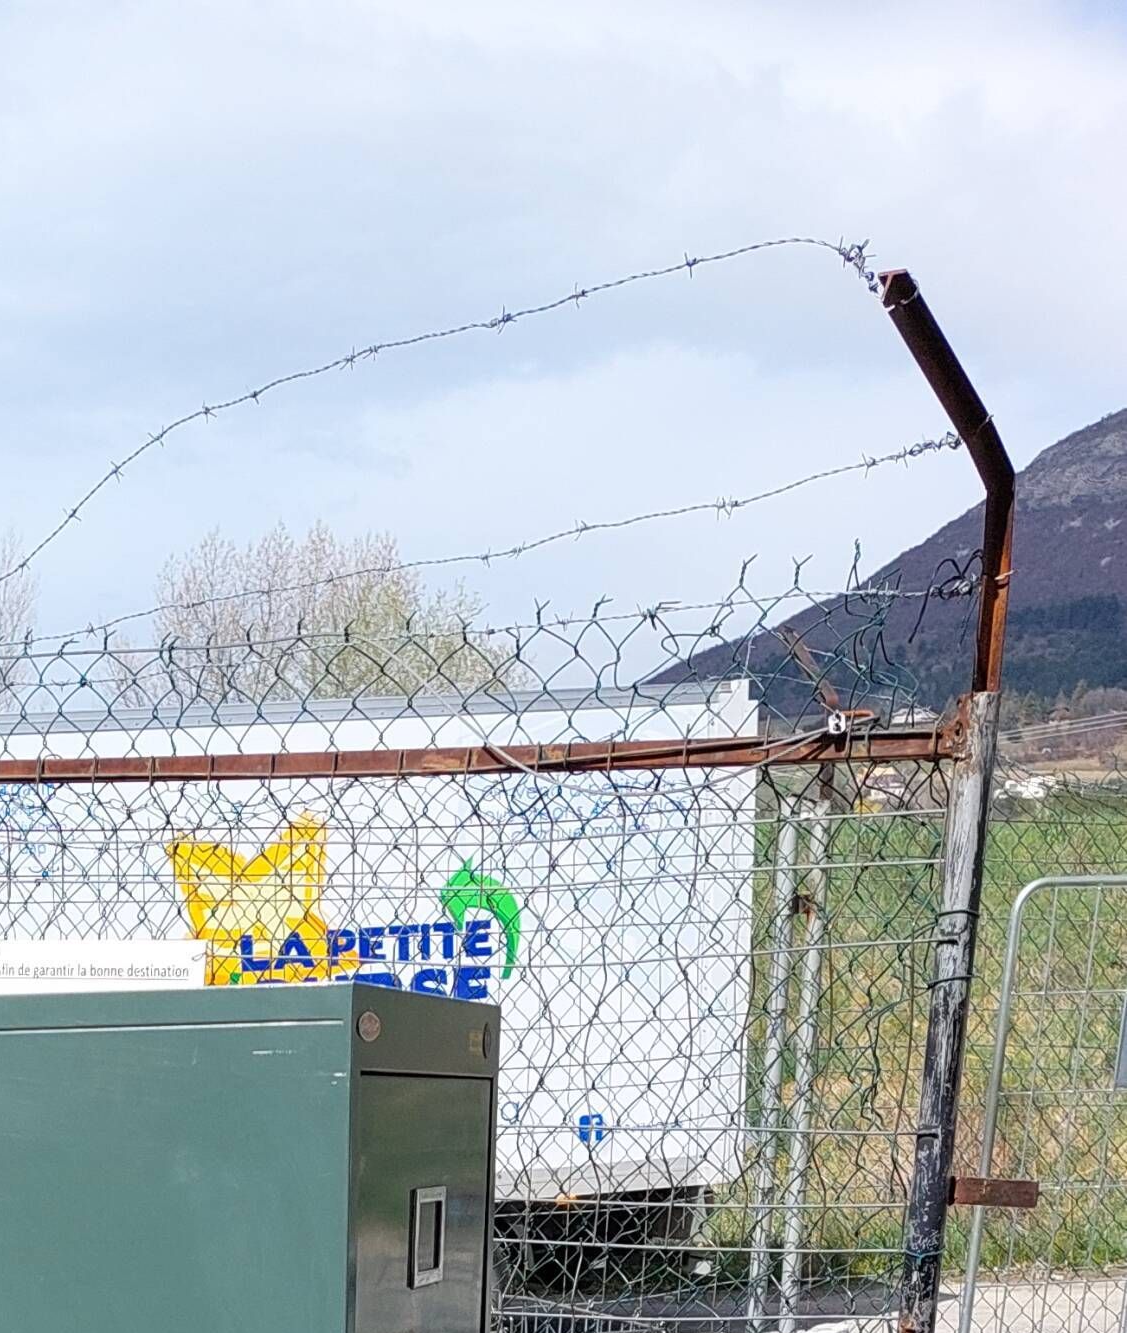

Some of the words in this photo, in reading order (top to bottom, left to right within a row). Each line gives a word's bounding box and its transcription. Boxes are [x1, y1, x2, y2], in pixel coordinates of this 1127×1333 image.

[240, 931, 315, 973] LA
[324, 919, 493, 966] PETITE
[18, 963, 31, 977] de
[33, 963, 75, 980] garantir
[77, 963, 87, 977] la
[90, 963, 124, 978] bonne
[126, 963, 190, 978] destination
